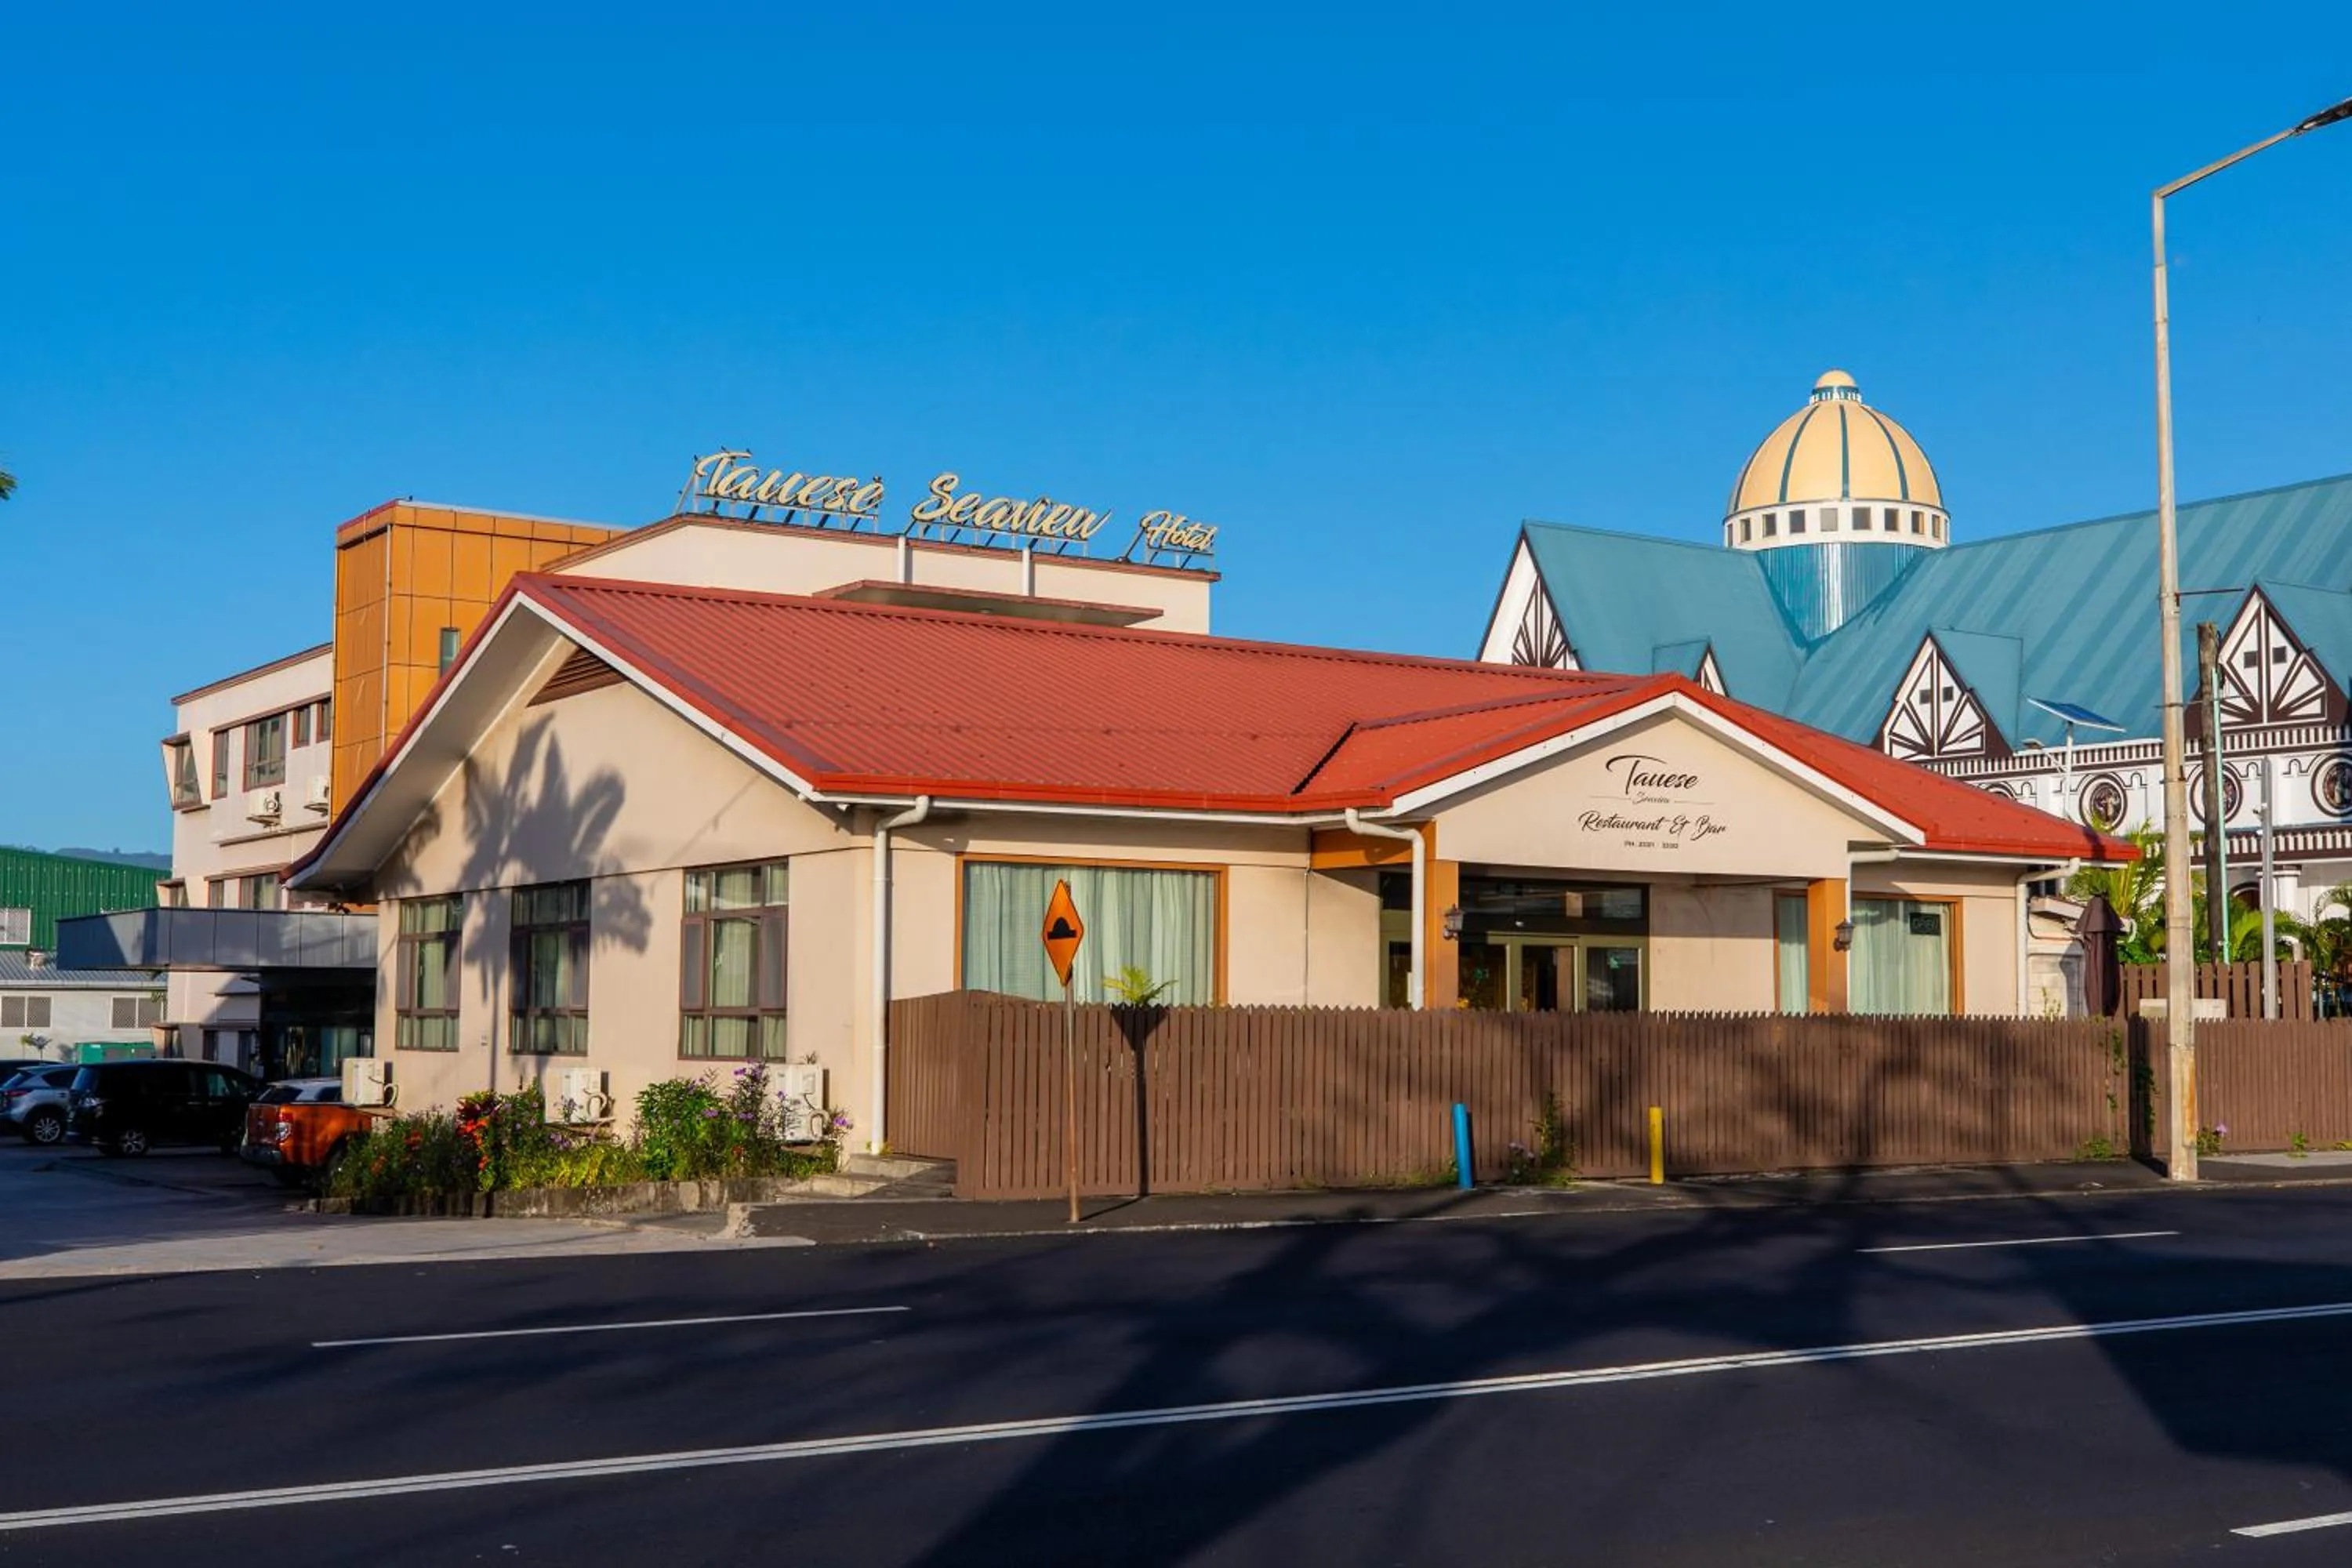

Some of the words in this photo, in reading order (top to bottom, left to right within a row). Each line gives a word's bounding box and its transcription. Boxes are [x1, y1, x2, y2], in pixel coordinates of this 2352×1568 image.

[695, 452, 884, 514] Tauese
[912, 473, 1112, 540] Seaview
[1140, 510, 1218, 551] Hotel
[1606, 754, 1699, 795] Tauese
[1578, 810, 1669, 832] Restaurant
[1669, 815, 1691, 837] &
[1690, 815, 1726, 841] Bar
